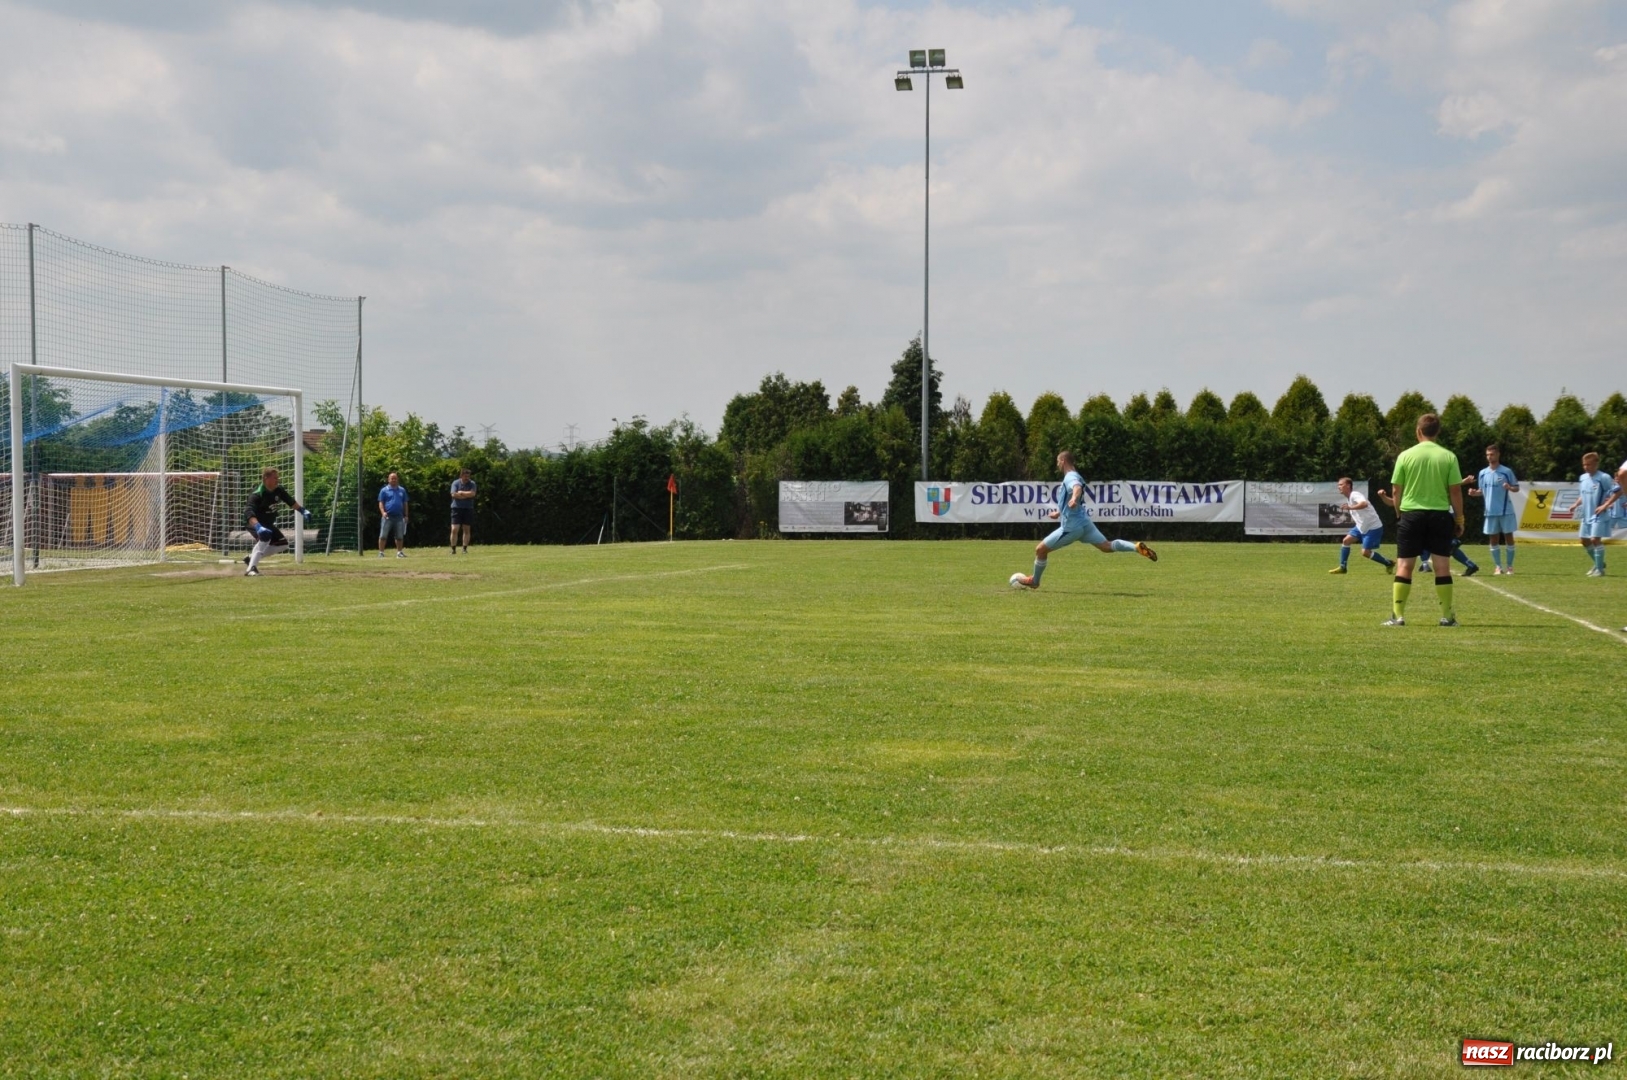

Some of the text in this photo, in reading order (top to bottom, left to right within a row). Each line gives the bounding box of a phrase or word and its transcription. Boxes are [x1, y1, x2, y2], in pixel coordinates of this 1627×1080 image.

[971, 484, 1229, 505] SERDECNIE WITAMY
[1023, 508, 1035, 517] w
[1099, 505, 1174, 517] raciborskim
